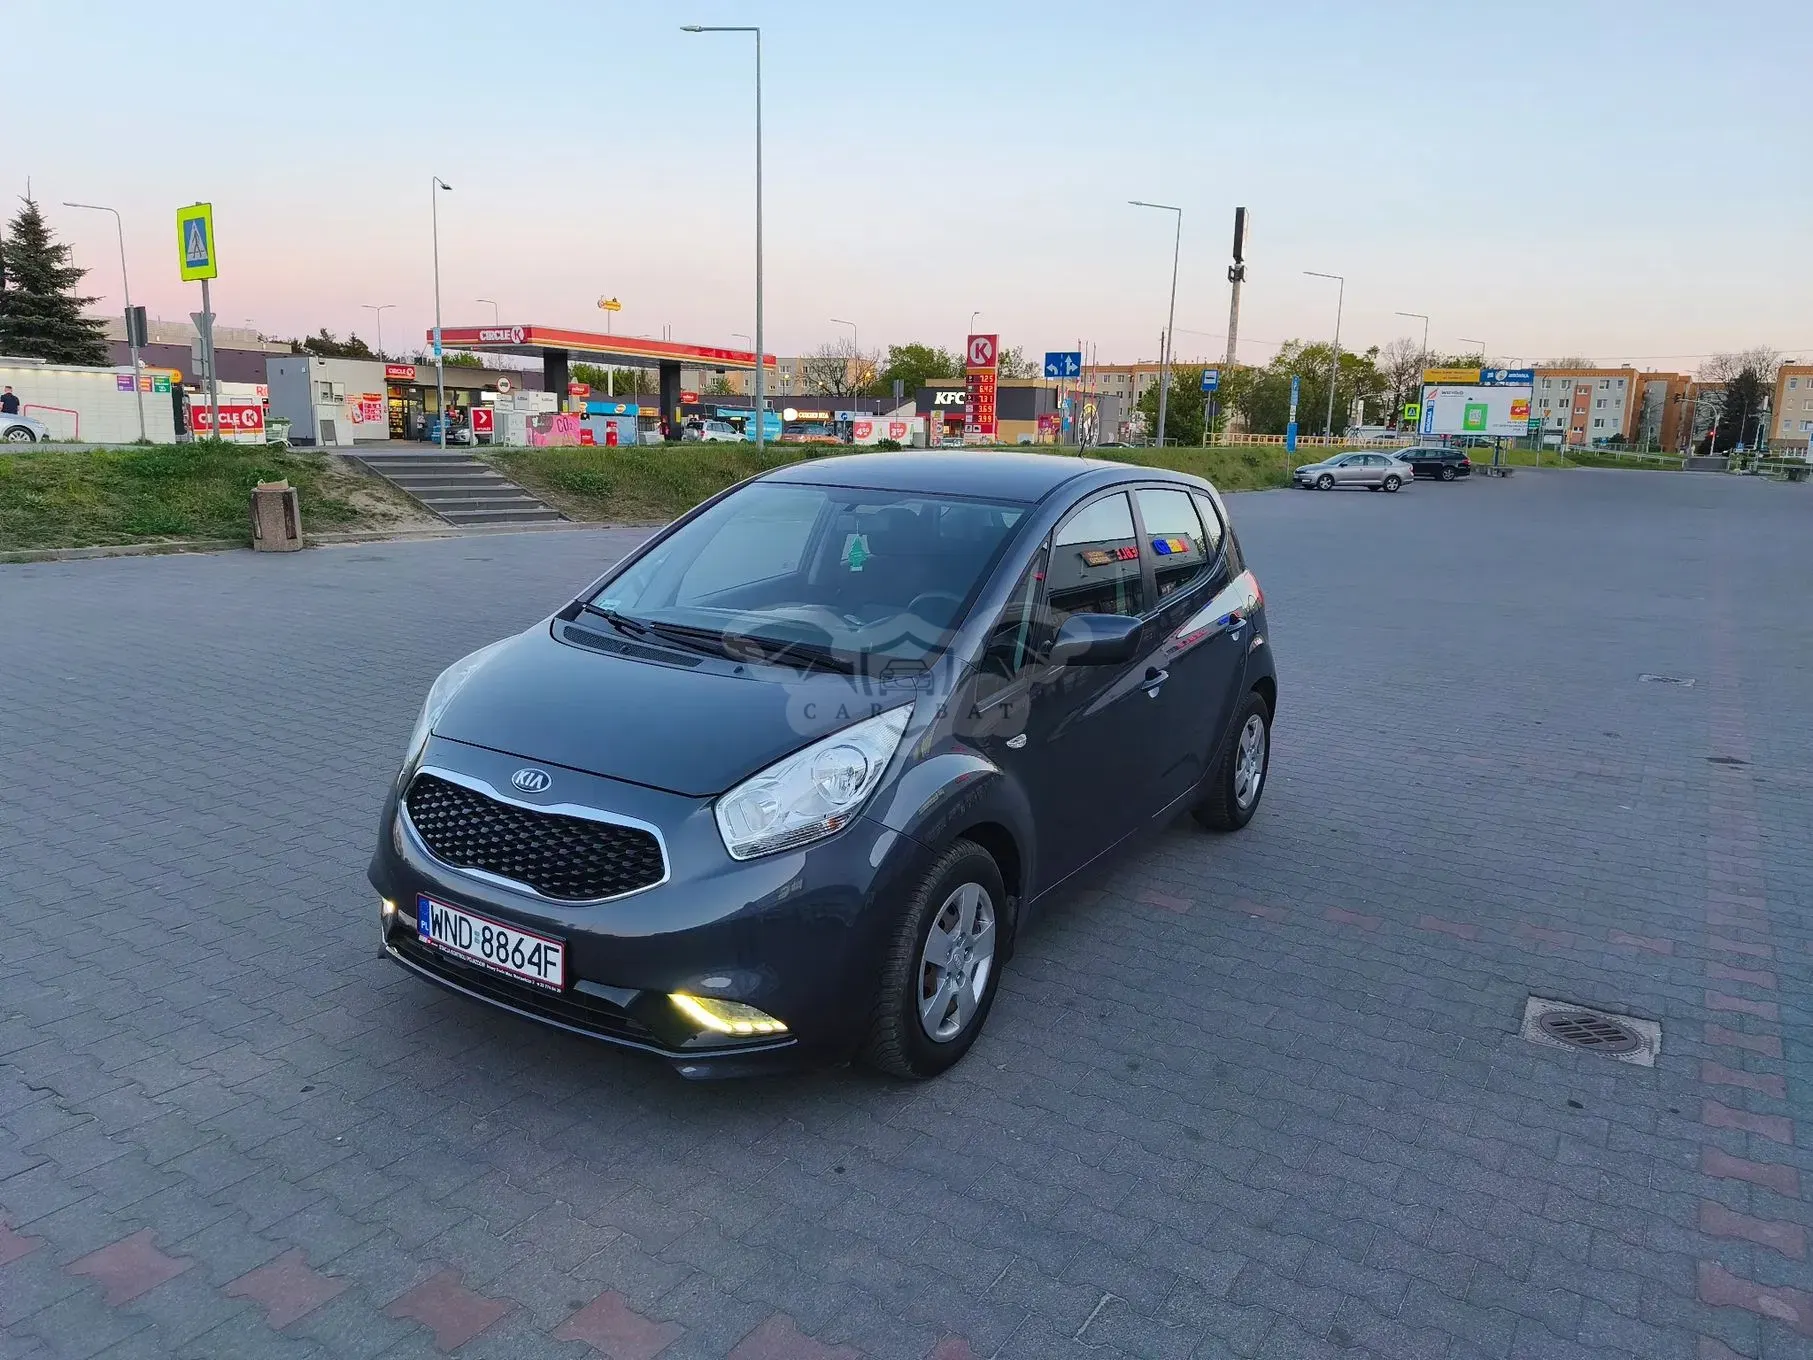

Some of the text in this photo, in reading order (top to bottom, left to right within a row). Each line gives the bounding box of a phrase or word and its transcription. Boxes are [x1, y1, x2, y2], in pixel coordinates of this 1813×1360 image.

[480, 327, 523, 344] CIRCLE K
[973, 339, 992, 364] K
[934, 391, 965, 405] KFC
[198, 409, 258, 426] CICLE K
[515, 771, 544, 789] KIA
[420, 919, 430, 932] PL
[431, 904, 560, 978] WND 8864F
